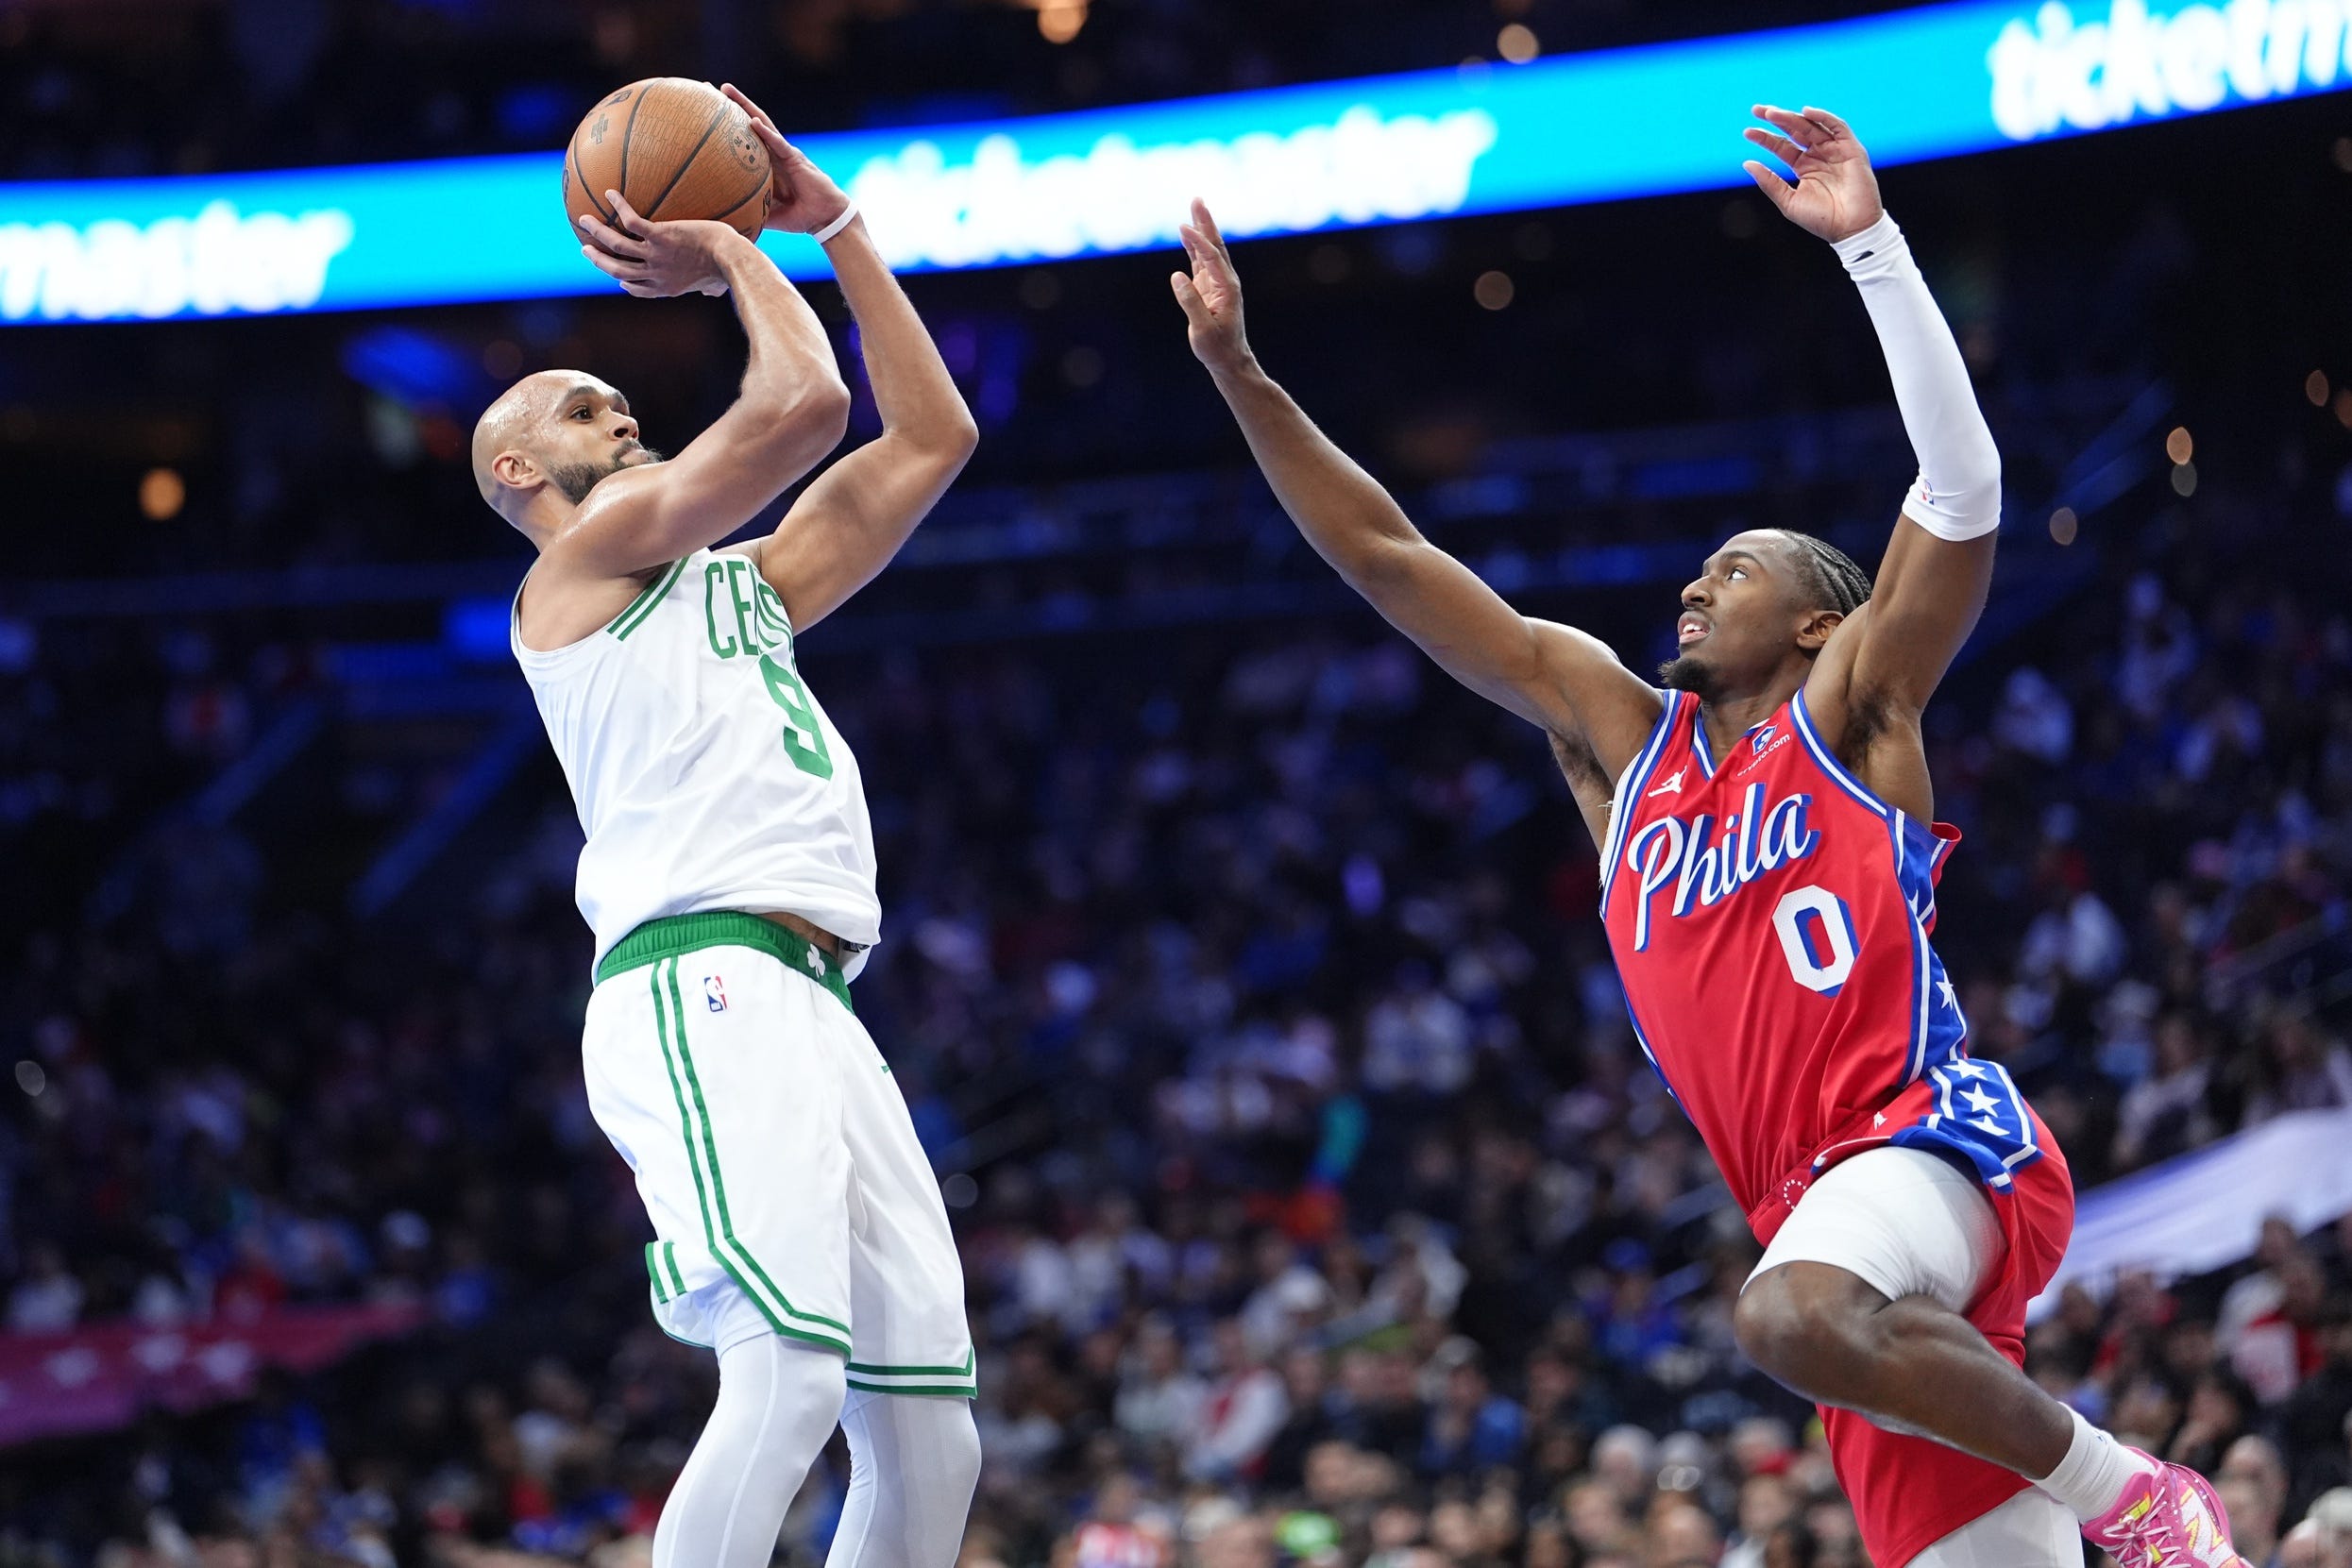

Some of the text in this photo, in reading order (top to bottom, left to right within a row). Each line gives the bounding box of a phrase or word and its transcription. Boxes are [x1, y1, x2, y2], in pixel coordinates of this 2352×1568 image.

[758, 652, 834, 782] 9
[1736, 733, 1791, 777] crypto.com
[1627, 783, 1821, 953] Phila
[1771, 885, 1860, 998] 0
